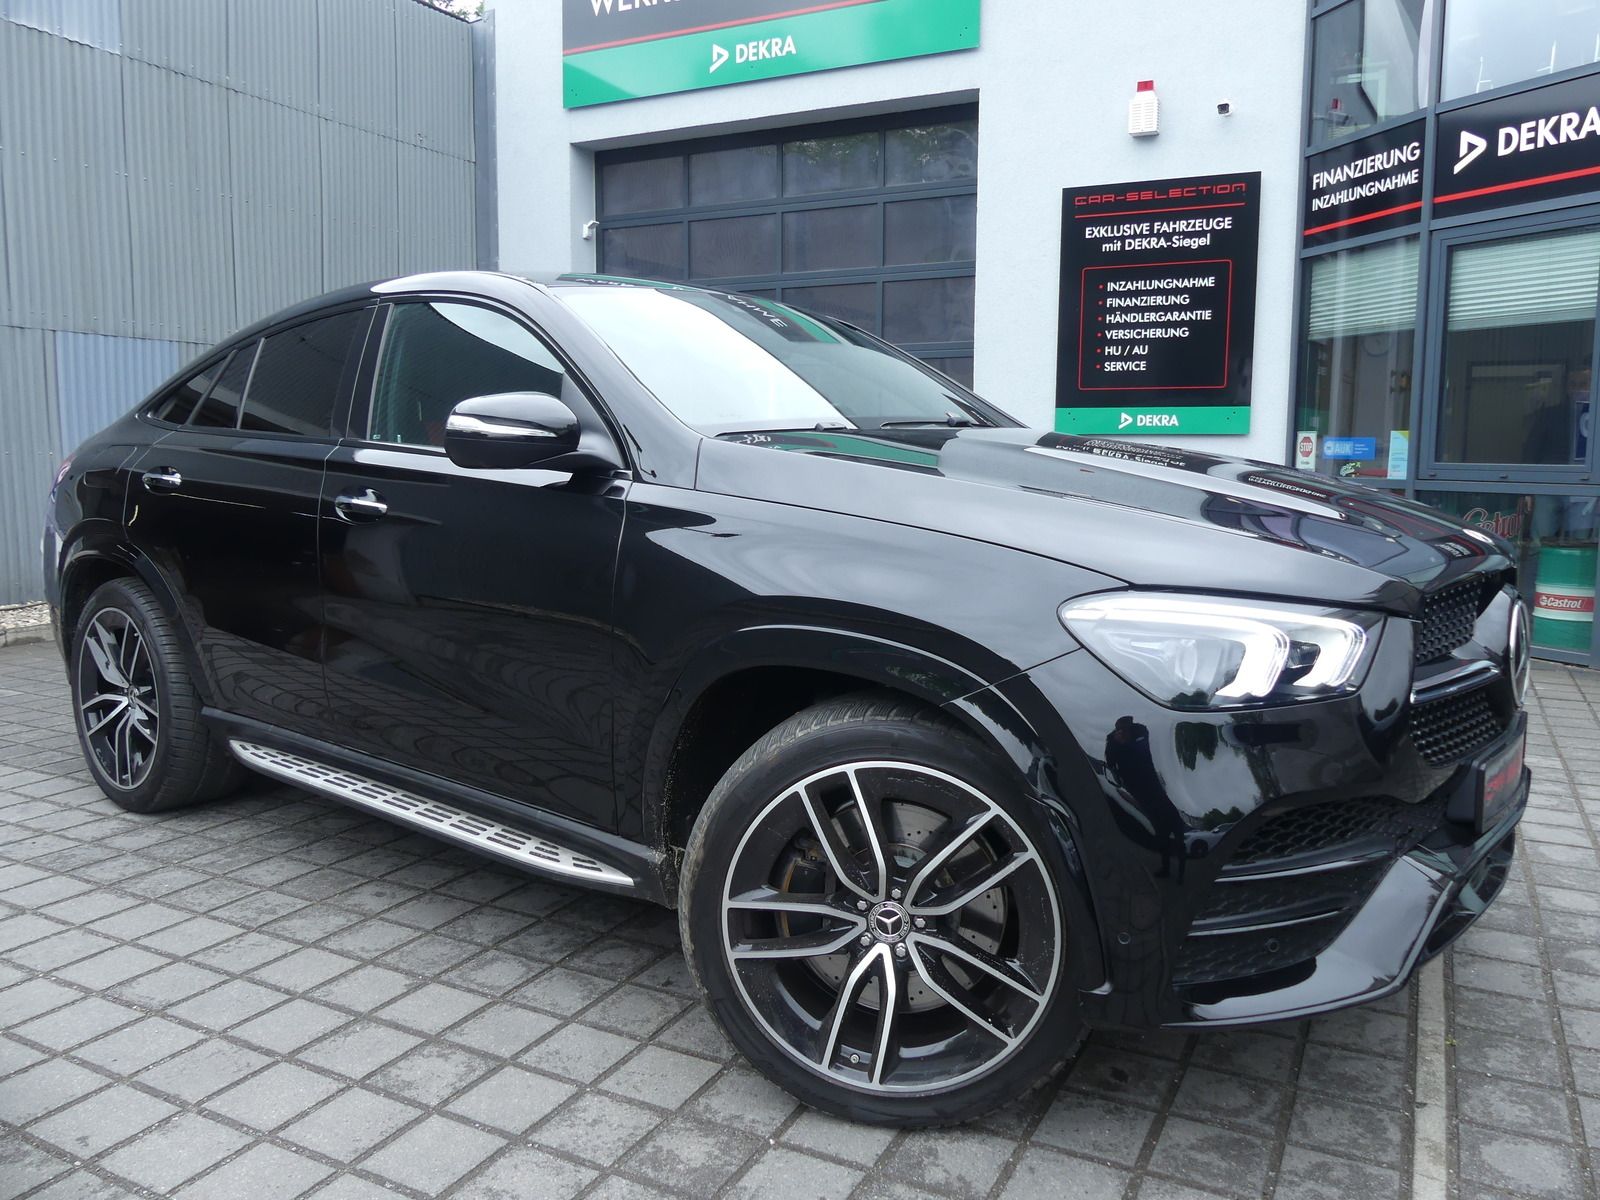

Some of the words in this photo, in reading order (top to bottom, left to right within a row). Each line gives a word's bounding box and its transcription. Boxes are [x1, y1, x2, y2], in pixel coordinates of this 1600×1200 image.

[735, 35, 797, 64] DEKRA
[1497, 106, 1600, 157] DEKRA
[1312, 141, 1421, 190] FINANZIERUNG
[1074, 182, 1247, 206] CAR-SELECTION
[1312, 169, 1419, 211] INZAHLUNGNAHME
[1085, 222, 1150, 239] EXKLUSIVE
[1153, 217, 1233, 234] FAHRZEUGE
[1102, 239, 1121, 252] mit
[1125, 233, 1211, 251] DEKRA-Siegel
[1106, 276, 1216, 292] INZAHLUNGNAHME
[1106, 294, 1190, 308] FINANZIERUNG
[1106, 310, 1213, 324] HÄNDLERGARANTIE
[1105, 327, 1190, 340] VERSICHERUNG
[1104, 346, 1121, 356] HU
[1132, 345, 1149, 355] AU
[1104, 361, 1147, 372] SERVICE
[1136, 414, 1179, 426] DEKRA
[1300, 442, 1313, 452] STOP
[1547, 597, 1582, 608] Castrol
